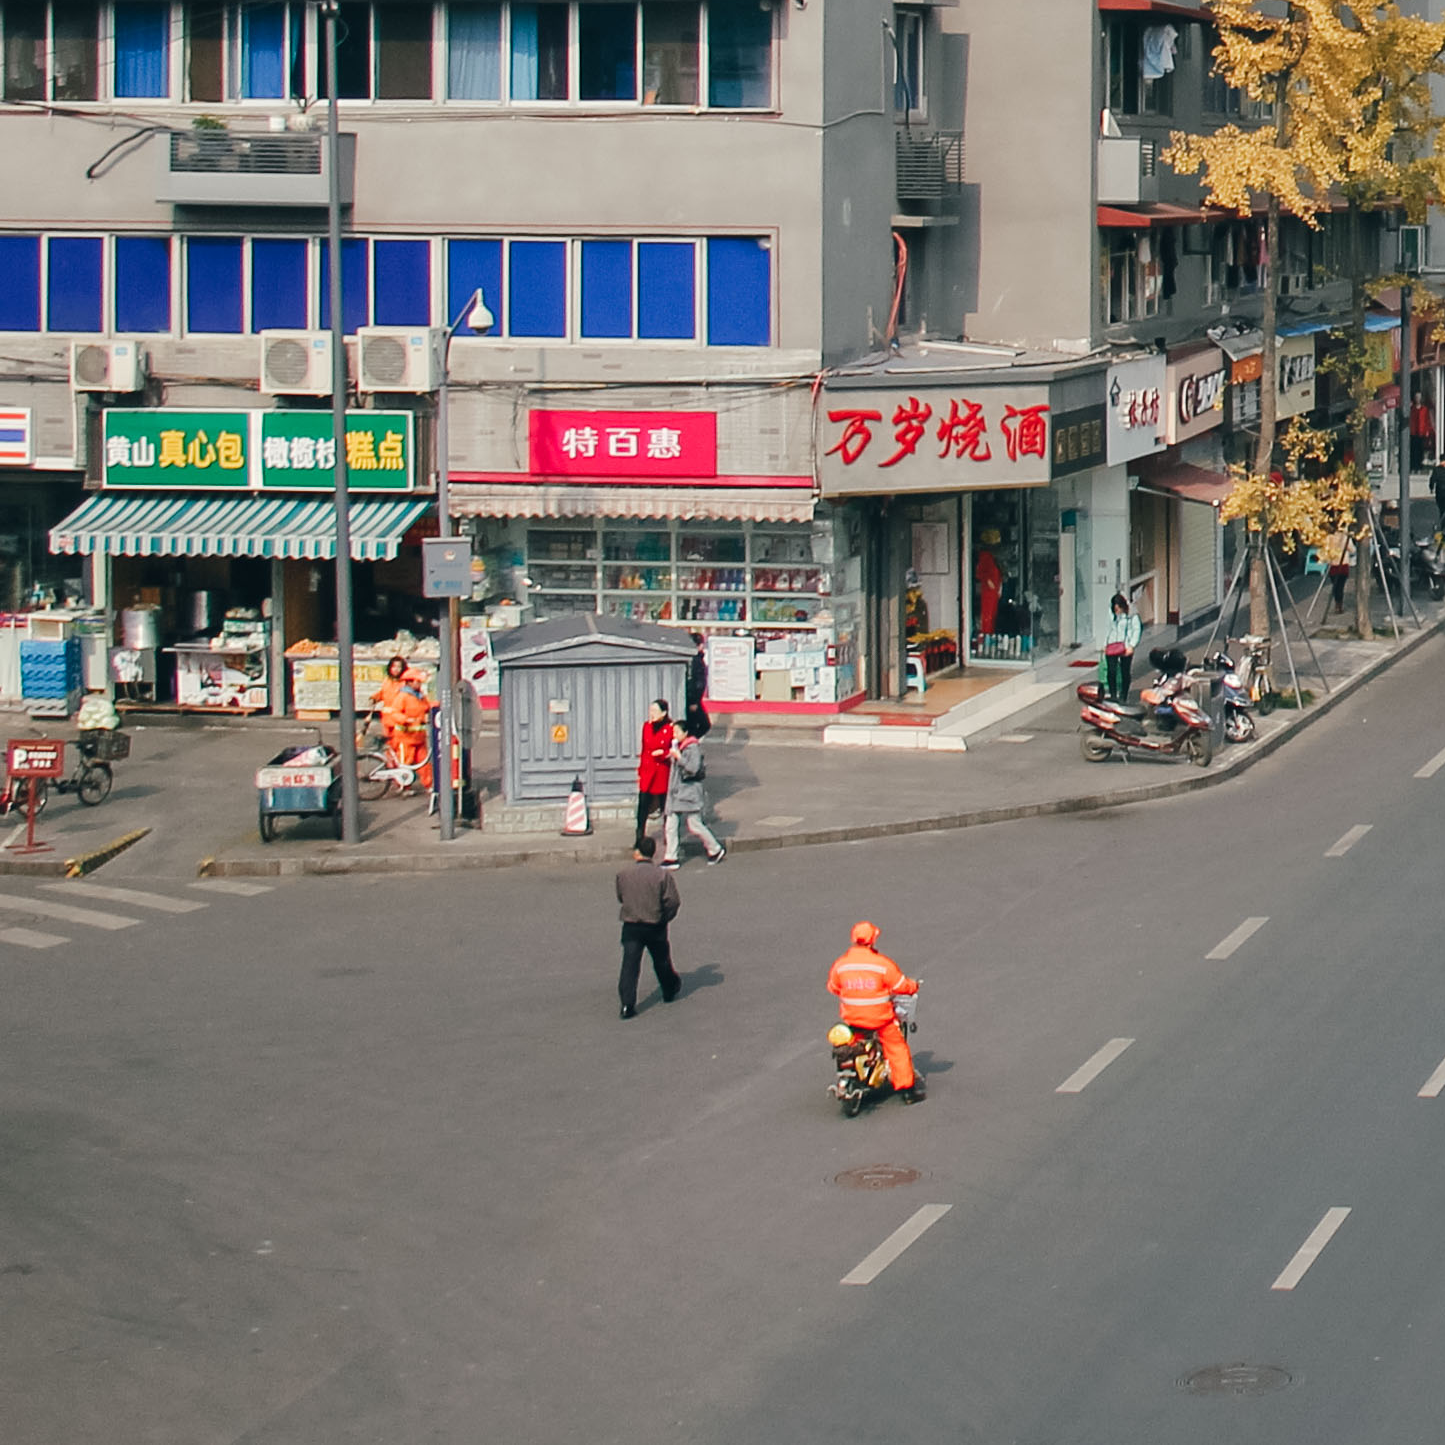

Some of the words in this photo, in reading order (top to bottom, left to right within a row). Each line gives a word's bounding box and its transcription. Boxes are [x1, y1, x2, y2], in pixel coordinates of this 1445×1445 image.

[562, 426, 682, 459] 特百惠
[824, 396, 1051, 468] 万岁烧酒
